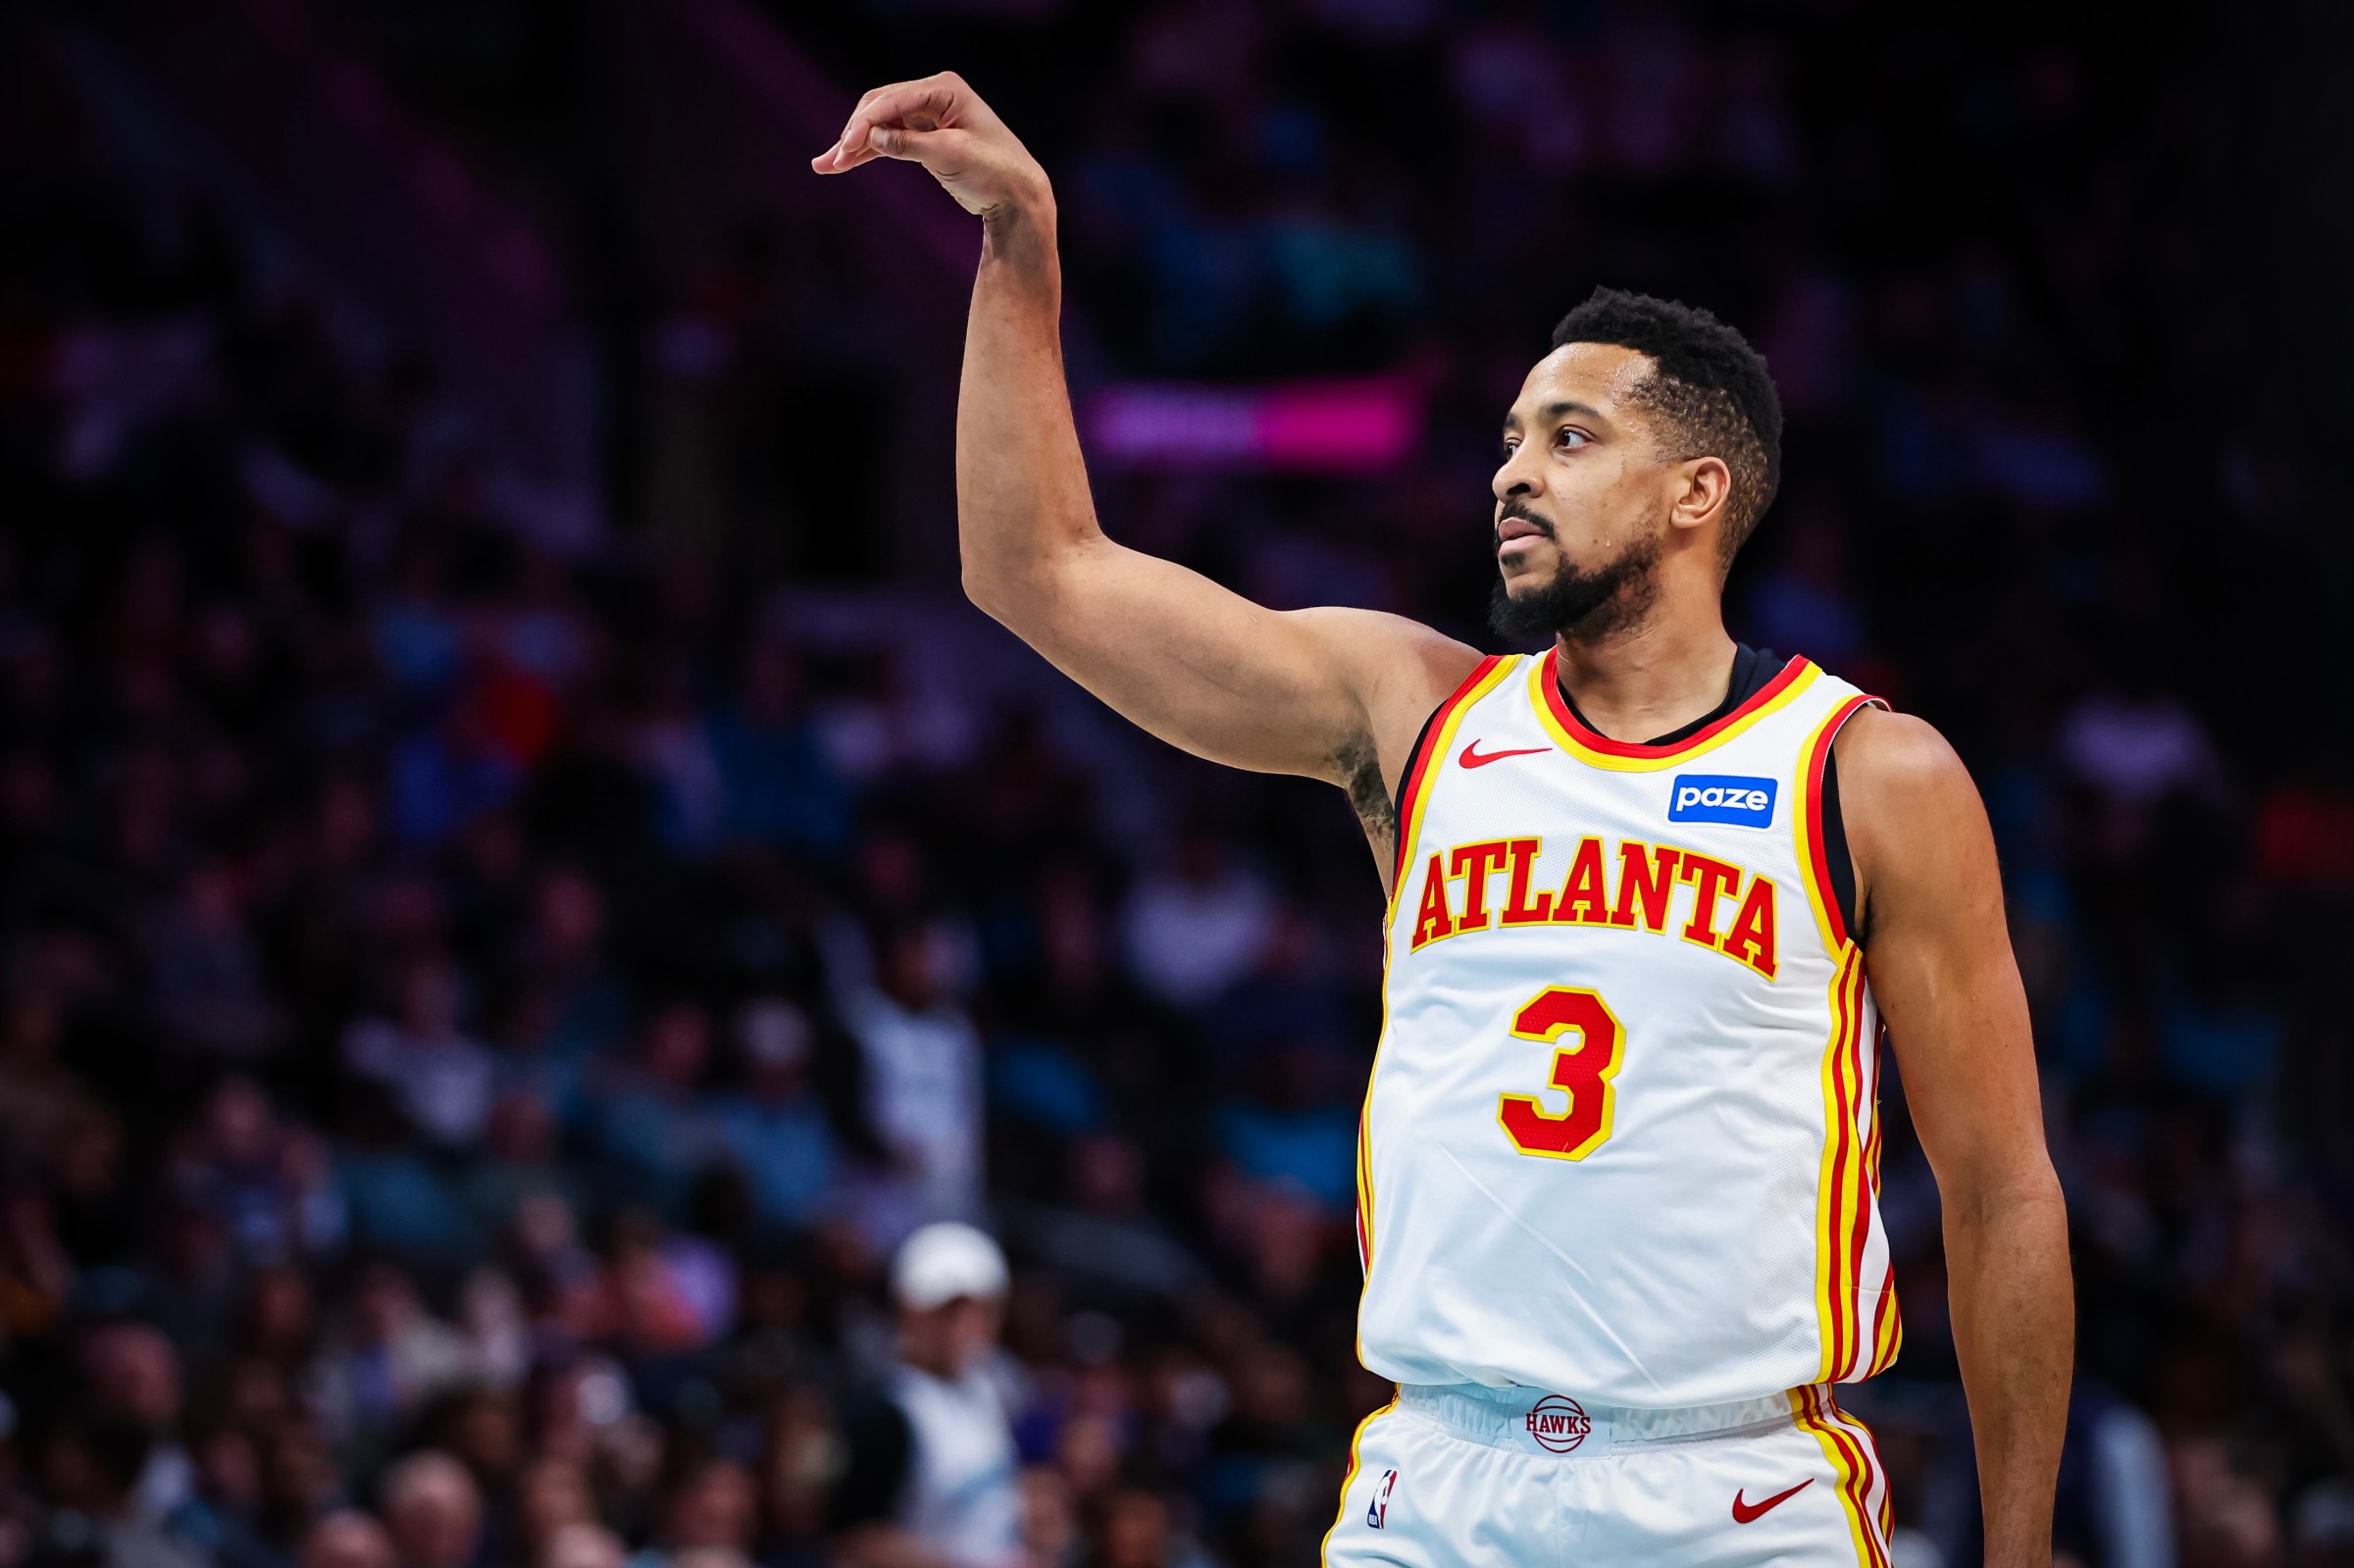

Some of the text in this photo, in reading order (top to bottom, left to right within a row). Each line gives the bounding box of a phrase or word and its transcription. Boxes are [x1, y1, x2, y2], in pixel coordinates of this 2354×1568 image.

[1675, 786, 1768, 812] paze
[1409, 835, 1780, 982] ATLANTA
[1497, 985, 1626, 1162] 3
[1525, 1413, 1591, 1434] HAWKS
